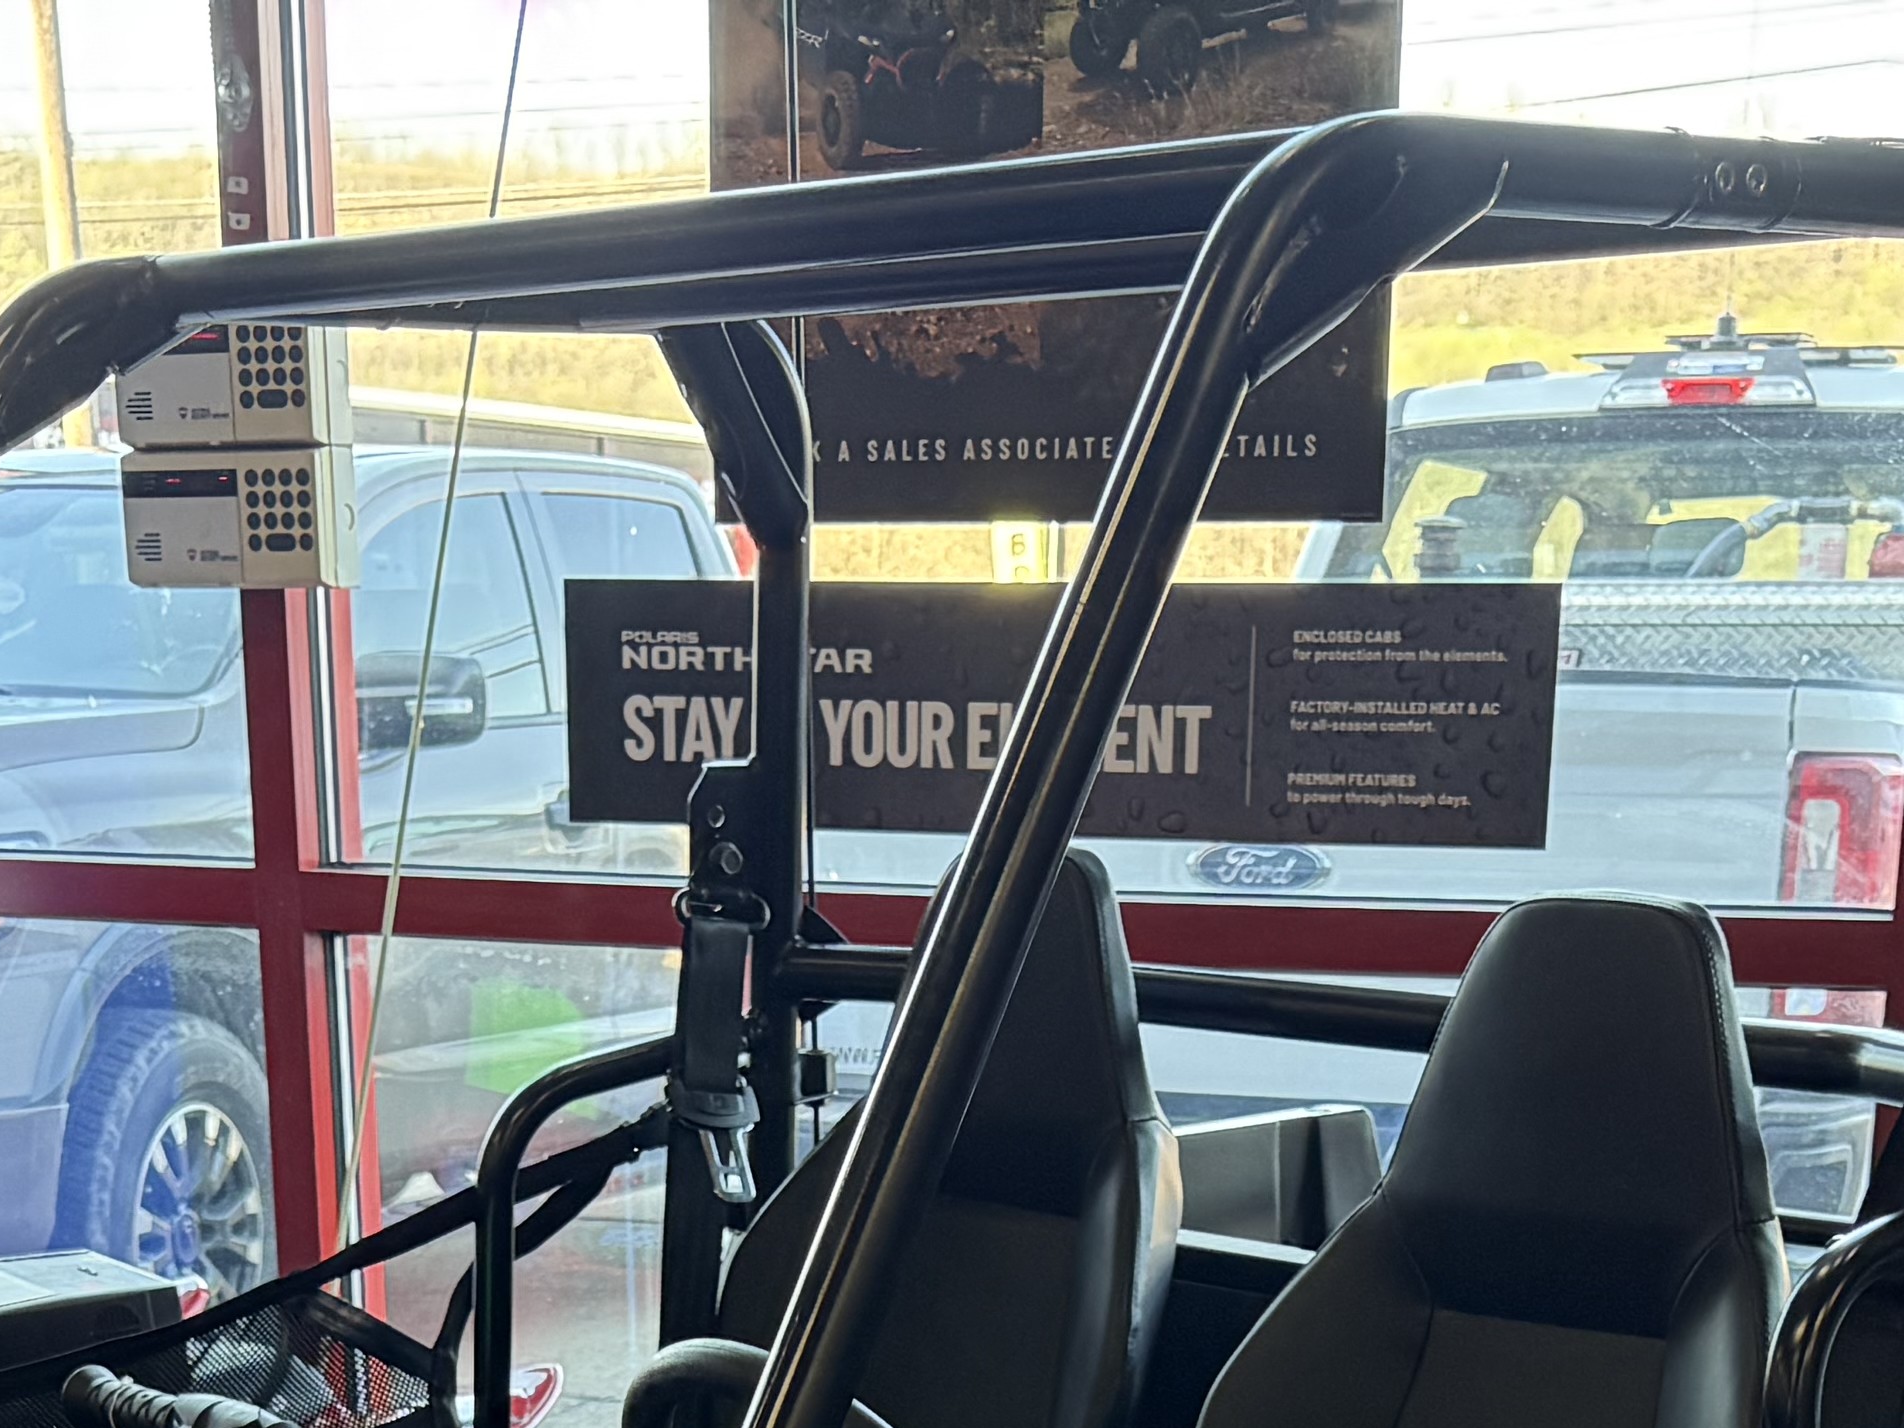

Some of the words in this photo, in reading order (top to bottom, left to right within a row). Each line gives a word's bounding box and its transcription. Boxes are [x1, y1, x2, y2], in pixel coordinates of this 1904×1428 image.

[838, 440, 852, 461] A
[867, 439, 948, 461] SALES
[963, 436, 1113, 461] ASSOCIATE
[1223, 433, 1318, 459] TAILS
[621, 631, 699, 643] POLARIS
[1293, 630, 1364, 643] ENCLOSED
[1365, 630, 1401, 643] CABS
[622, 645, 873, 674] NORTHAR
[1293, 648, 1310, 660] for
[1314, 649, 1382, 663] protection
[1385, 649, 1416, 661] from
[1419, 649, 1441, 661] the
[1290, 701, 1427, 714] FACTORY-INSTALLED
[1429, 702, 1464, 714] HEAT
[1468, 702, 1478, 715] &
[1481, 702, 1500, 715] AC
[1290, 718, 1309, 730] for
[1311, 718, 1378, 731] all-season
[623, 694, 744, 762] STAY
[818, 699, 955, 769] YOUR
[967, 701, 1212, 774] EENT
[1287, 773, 1345, 786] PREMIUM
[1348, 773, 1416, 787] FEATURES
[1287, 791, 1301, 803] to
[1303, 793, 1343, 805] power
[1345, 792, 1395, 807] through
[1398, 793, 1436, 808] tough
[1216, 848, 1298, 885] Ford
